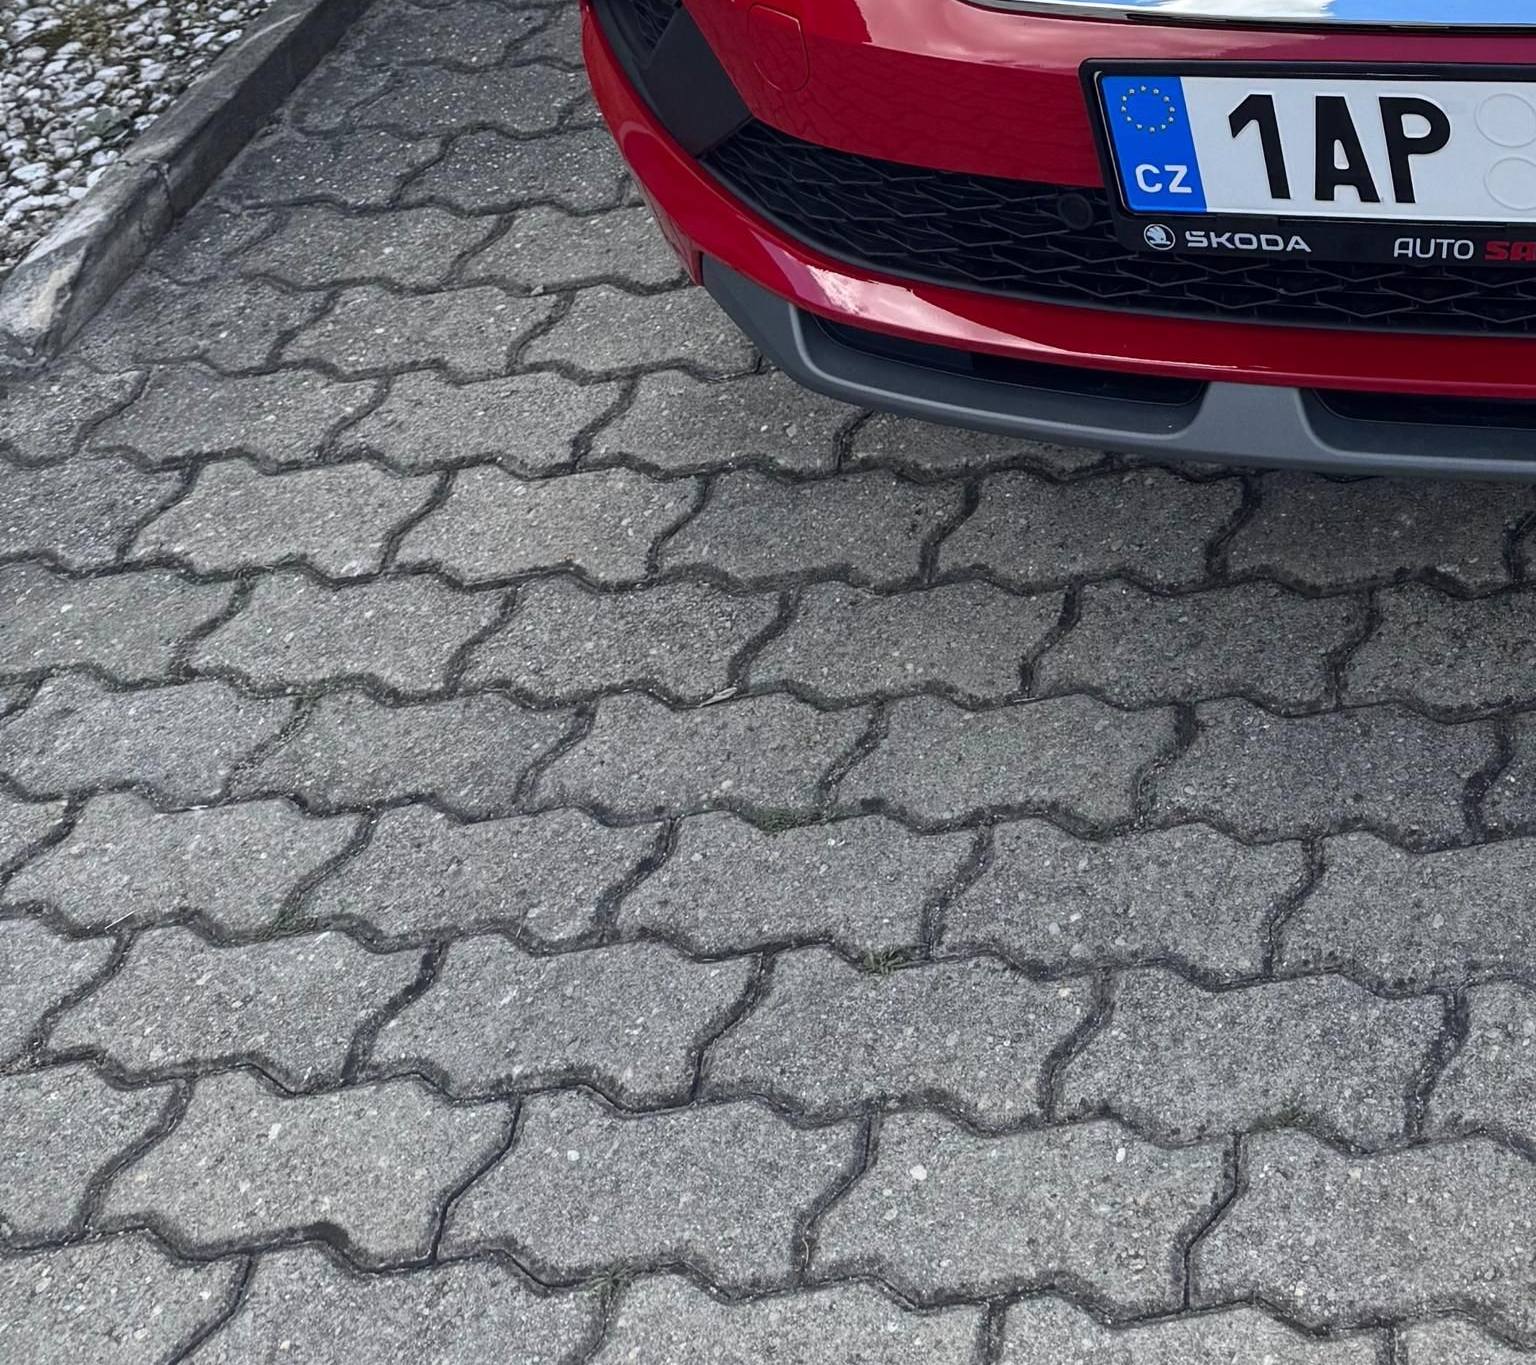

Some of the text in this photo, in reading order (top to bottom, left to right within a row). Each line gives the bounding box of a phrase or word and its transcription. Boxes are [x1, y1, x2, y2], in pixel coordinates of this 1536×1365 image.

[1228, 94, 1451, 204] 1AP
[1134, 164, 1193, 194] CZ
[1393, 237, 1475, 259] AUTO
